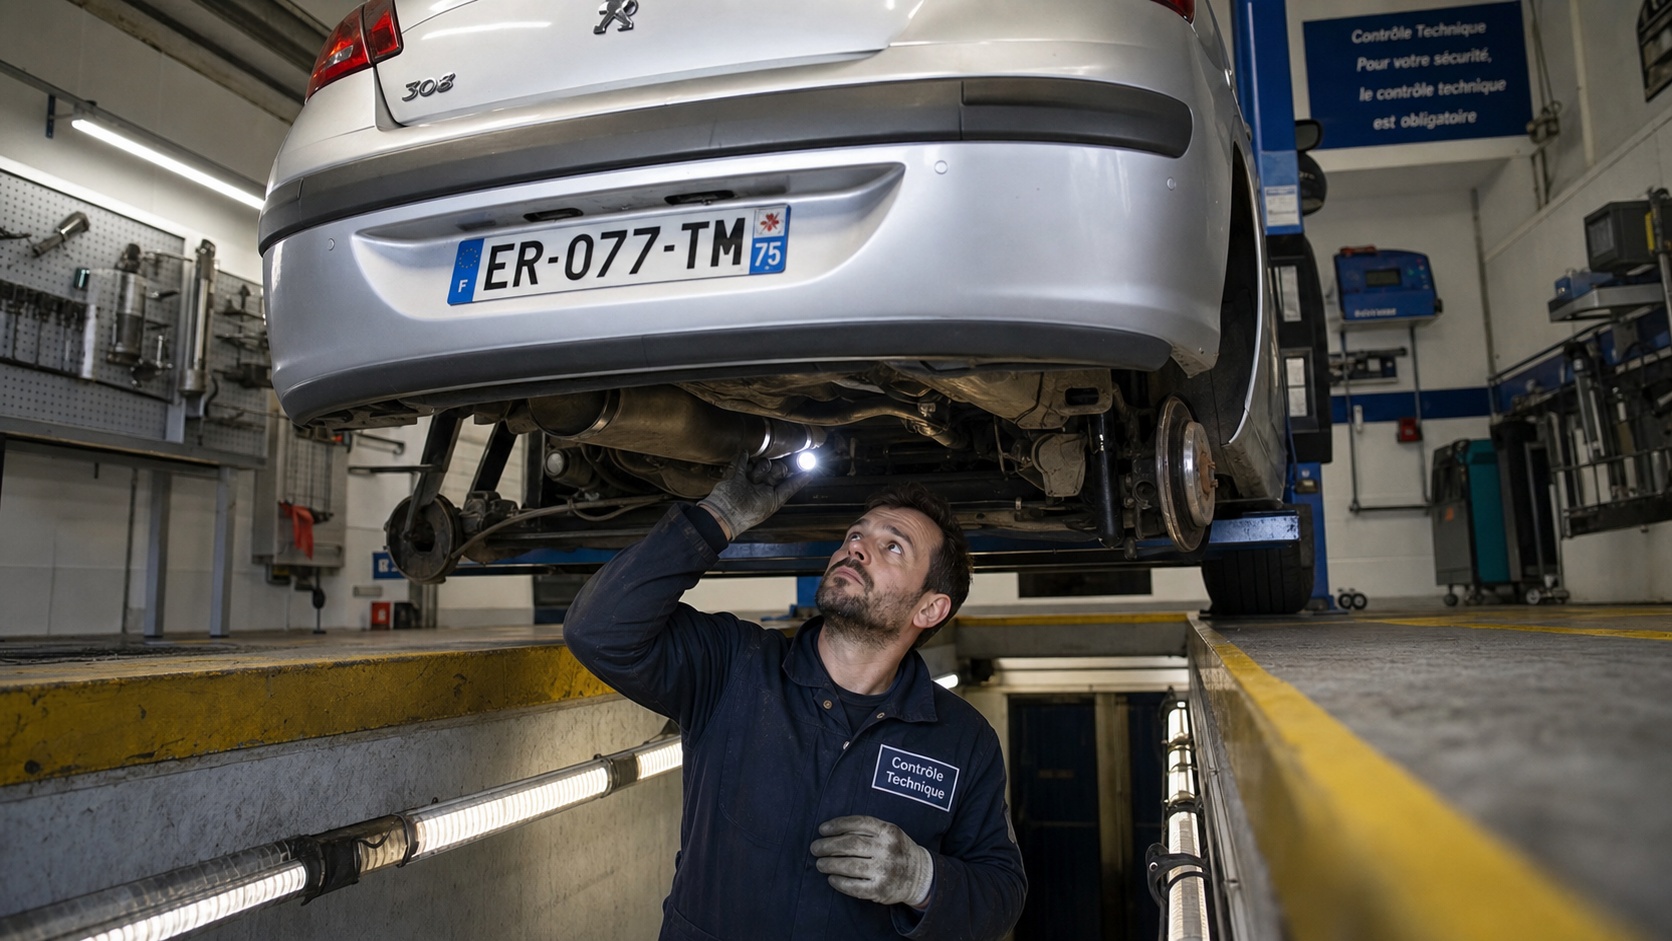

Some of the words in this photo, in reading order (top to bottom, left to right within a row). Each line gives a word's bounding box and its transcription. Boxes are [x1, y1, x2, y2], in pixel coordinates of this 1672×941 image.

[1351, 26, 1413, 44] Contrôle
[1416, 22, 1487, 38] Technique
[1356, 56, 1390, 72] Pour
[1393, 55, 1430, 69] votre
[1433, 47, 1492, 66] sécurité,
[401, 73, 456, 102] 308
[1359, 86, 1373, 102] le
[1376, 83, 1434, 101] contrôle
[1438, 77, 1507, 95] technique
[1373, 115, 1396, 130] est
[1400, 109, 1477, 129] obligatoire
[457, 279, 468, 292] F
[483, 217, 746, 291] ER-077-TM
[755, 241, 782, 267] 75
[891, 756, 944, 782] Contrôle
[886, 770, 945, 800] Technique
